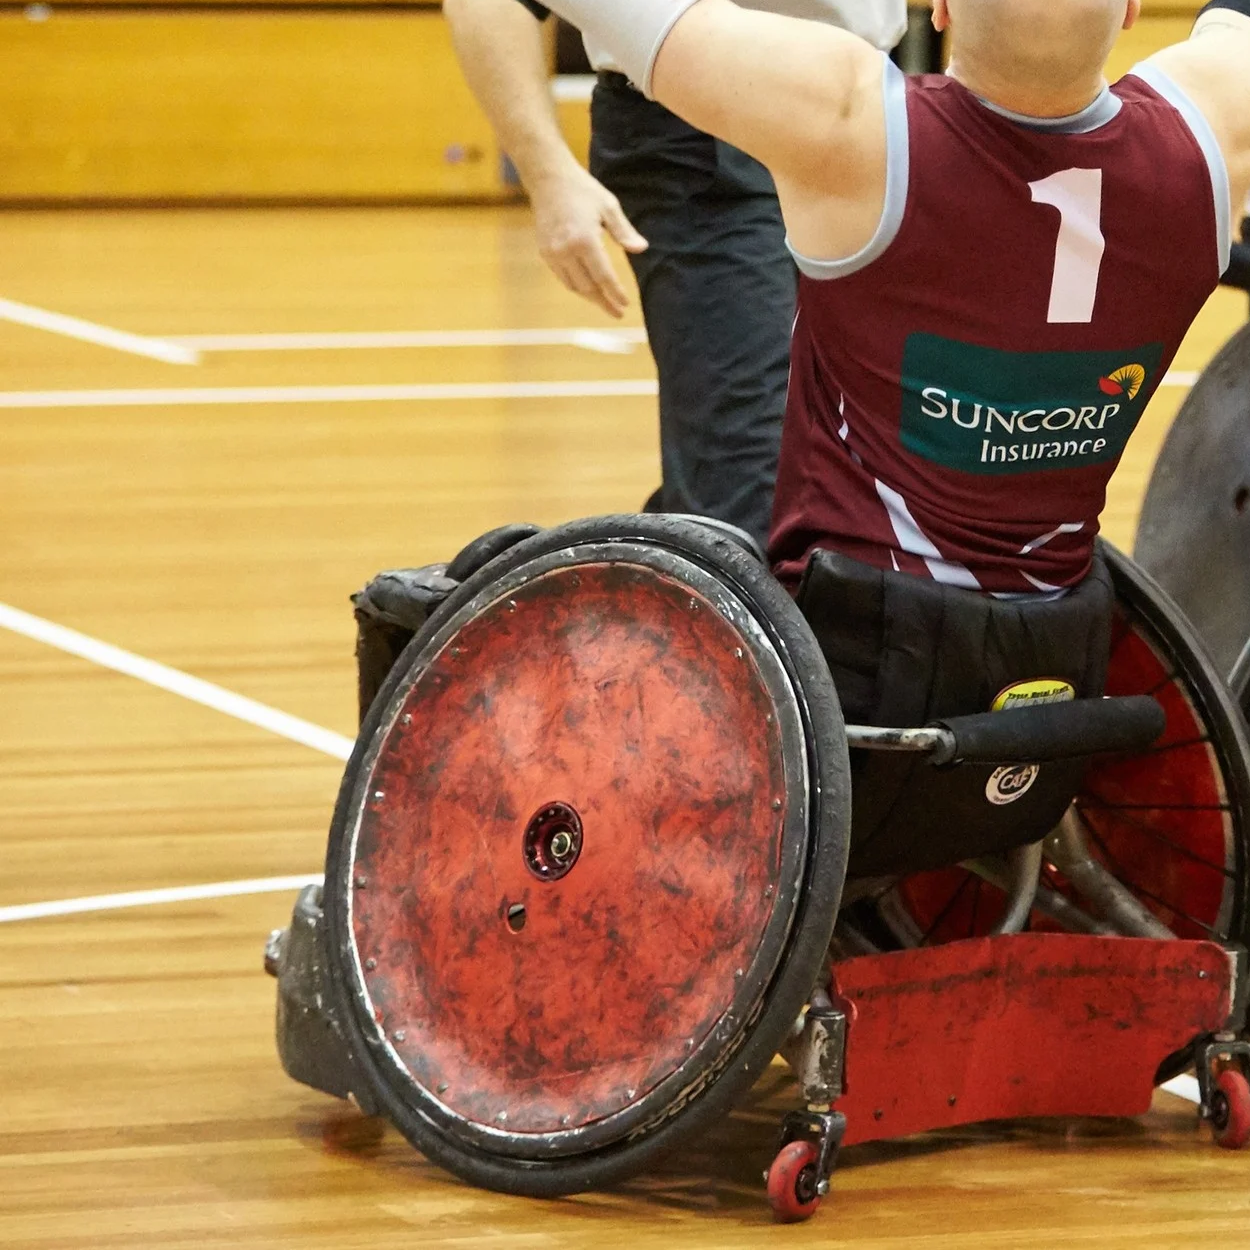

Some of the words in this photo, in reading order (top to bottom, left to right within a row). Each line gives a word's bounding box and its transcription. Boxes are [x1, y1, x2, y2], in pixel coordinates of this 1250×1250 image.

[1027, 167, 1105, 323] 1
[920, 387, 1120, 434] SUNCORP
[980, 438, 1107, 462] Insurance
